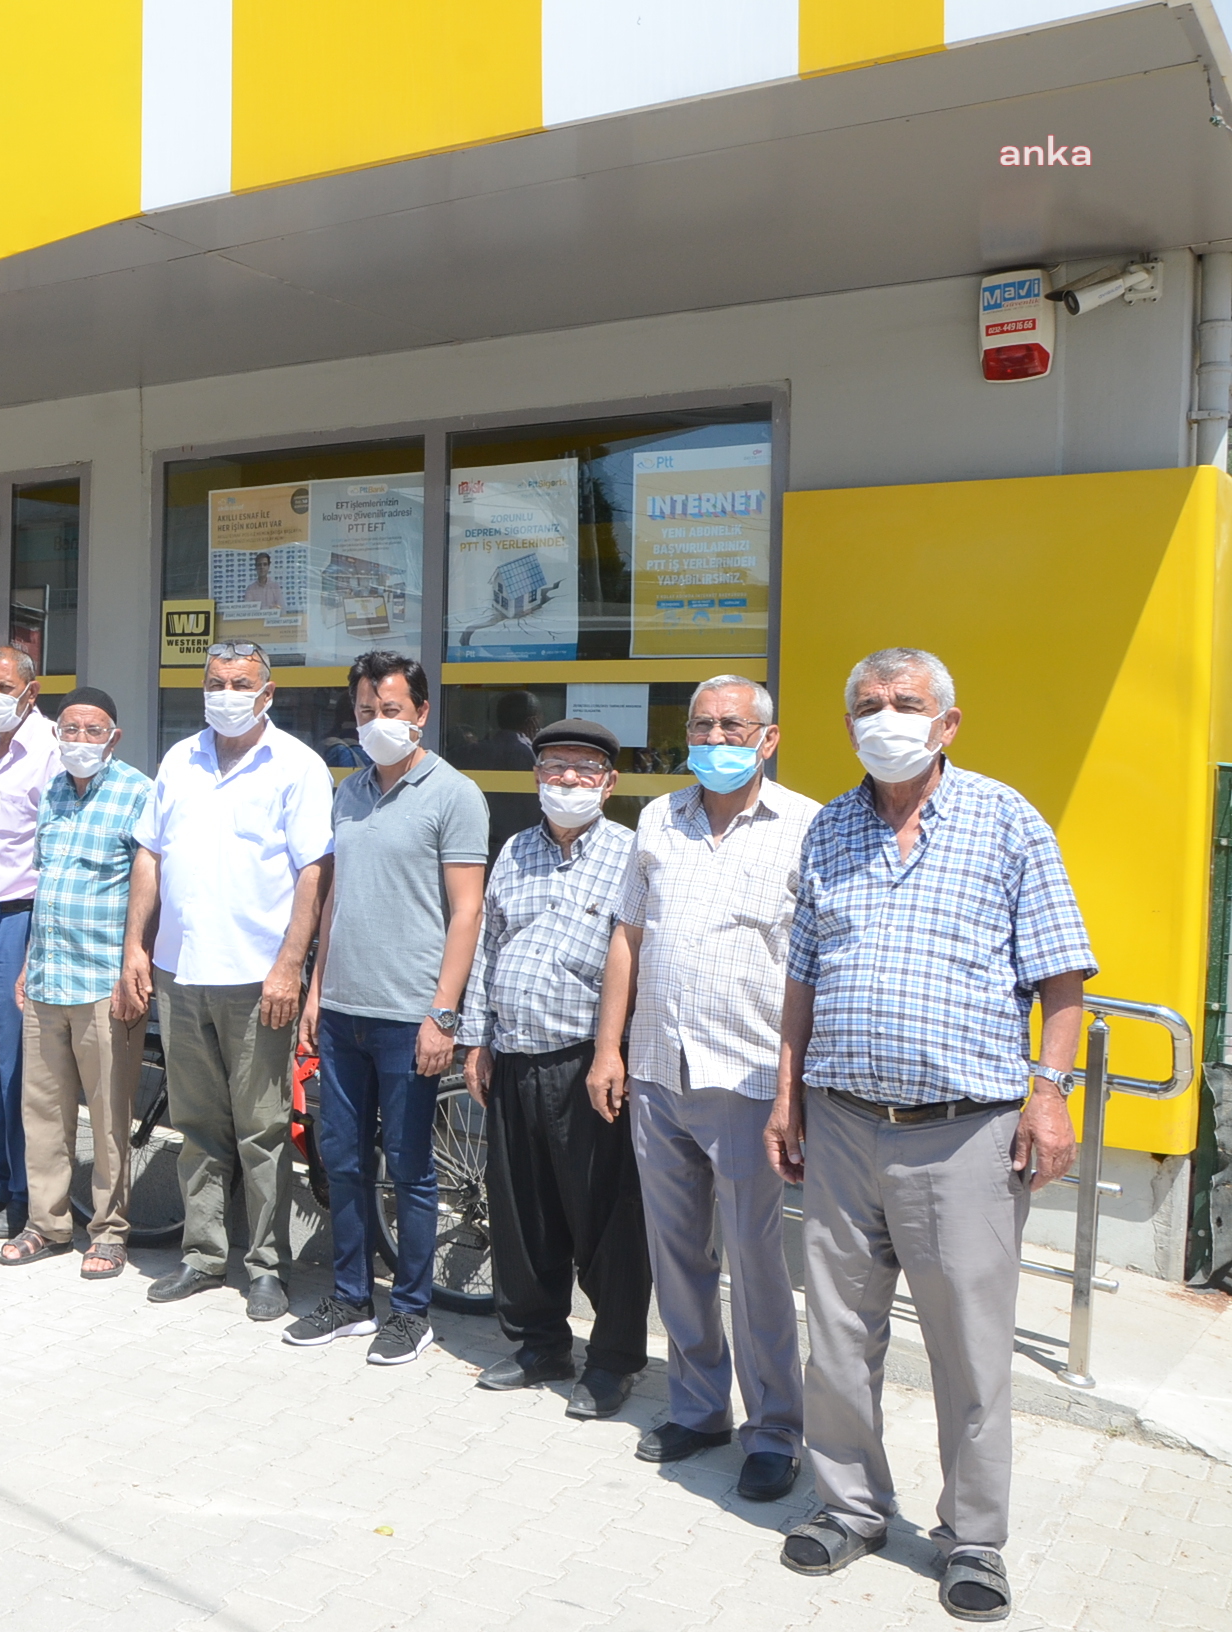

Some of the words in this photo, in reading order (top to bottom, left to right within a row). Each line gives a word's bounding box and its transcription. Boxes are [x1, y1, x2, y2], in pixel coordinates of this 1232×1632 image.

[983, 280, 1039, 307] Mavi
[656, 455, 674, 469] Ptt
[336, 501, 349, 510] EFT
[350, 498, 399, 511] işlemlerinizin
[647, 489, 764, 518] INTERNET
[217, 514, 238, 522] AKILLI
[239, 512, 259, 520] ESNAF
[260, 510, 270, 519] İLE
[322, 512, 342, 522] kolay
[353, 510, 387, 521] güvenilir
[387, 507, 412, 518] adresi
[490, 513, 533, 524] ZORUNLU
[231, 522, 245, 532] İŞİN
[246, 521, 268, 529] KOLAYI
[348, 523, 366, 533] PTT
[368, 521, 386, 532] EFT
[465, 528, 502, 538] DEPREM
[661, 527, 686, 539] YENİ
[688, 523, 743, 538] ABONELİK
[460, 541, 479, 552] PTT
[482, 538, 492, 553] İŞ
[495, 536, 565, 550] YERLERİNDE!
[653, 540, 751, 557] BAŞVURULARINIZI
[646, 560, 666, 571] PTT
[669, 558, 680, 573] İŞ
[682, 555, 758, 569] YERLERİNDEN
[168, 613, 206, 634] WU
